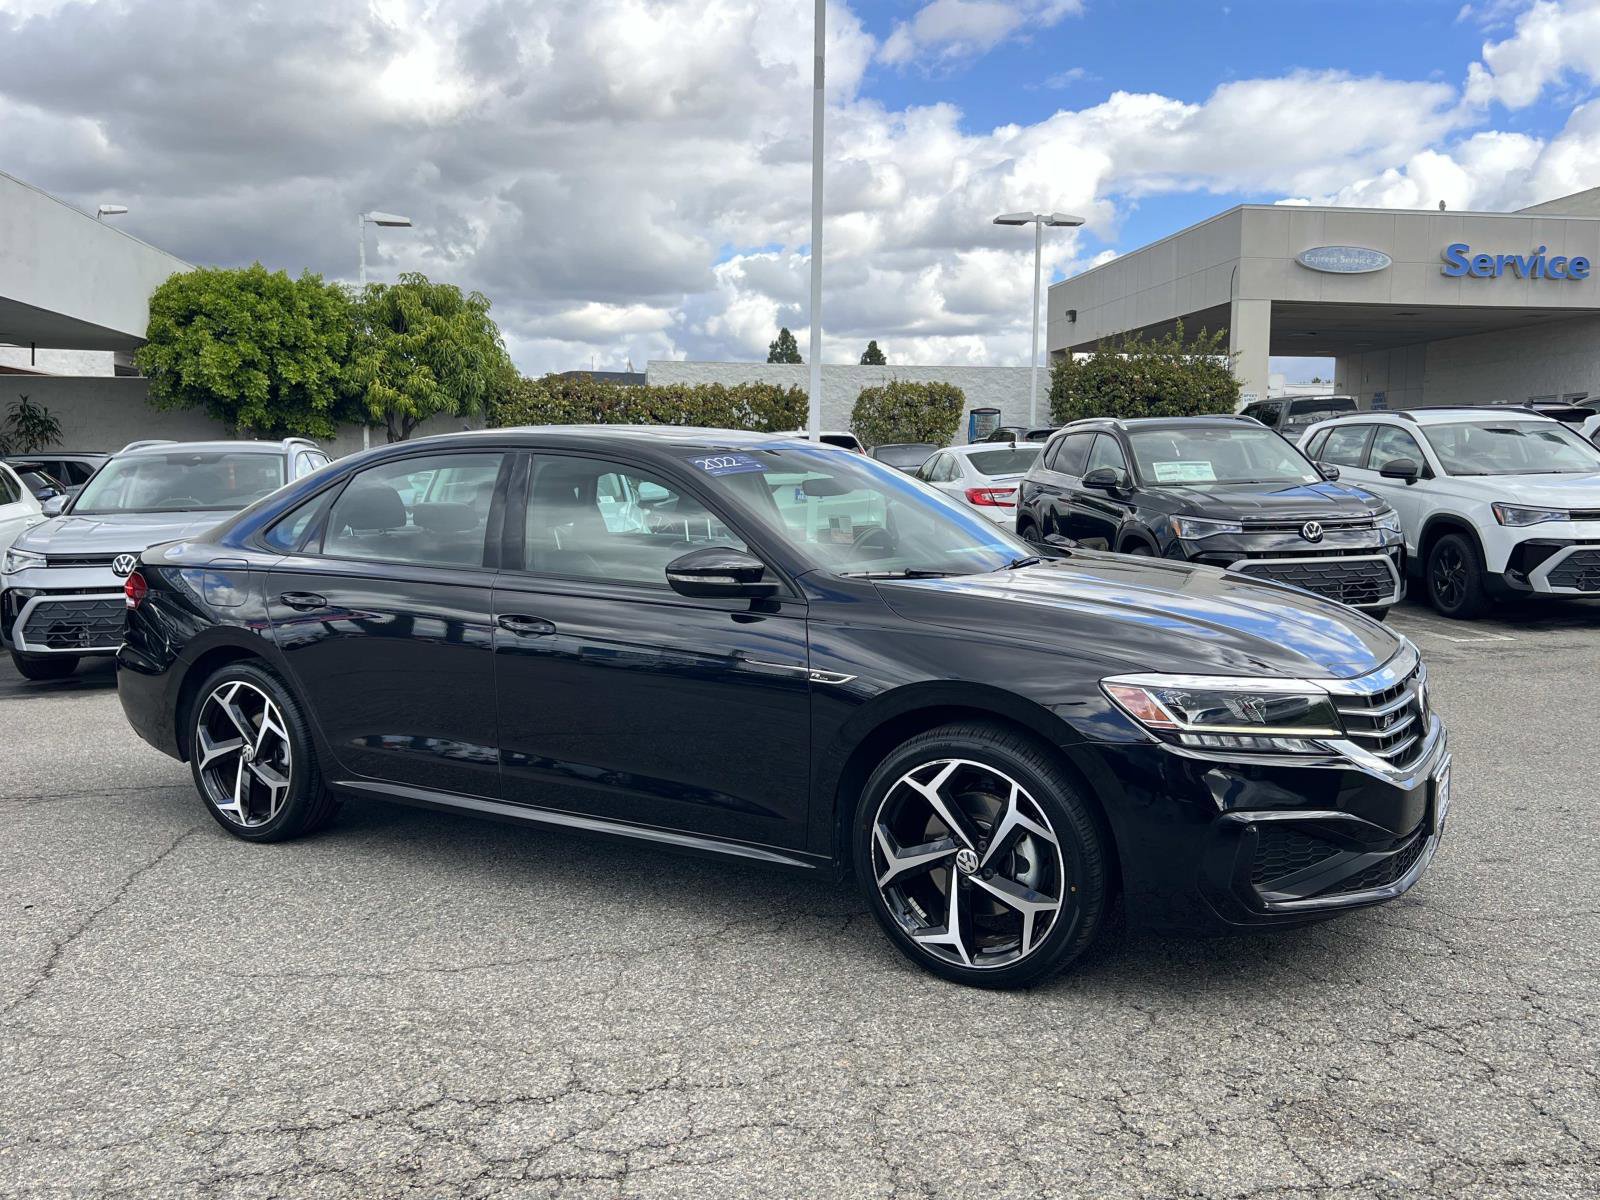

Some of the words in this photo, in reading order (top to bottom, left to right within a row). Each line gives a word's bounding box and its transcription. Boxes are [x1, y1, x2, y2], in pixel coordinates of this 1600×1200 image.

[1340, 255, 1372, 265] Service
[1442, 243, 1591, 280] Service
[695, 456, 742, 470] 2022
